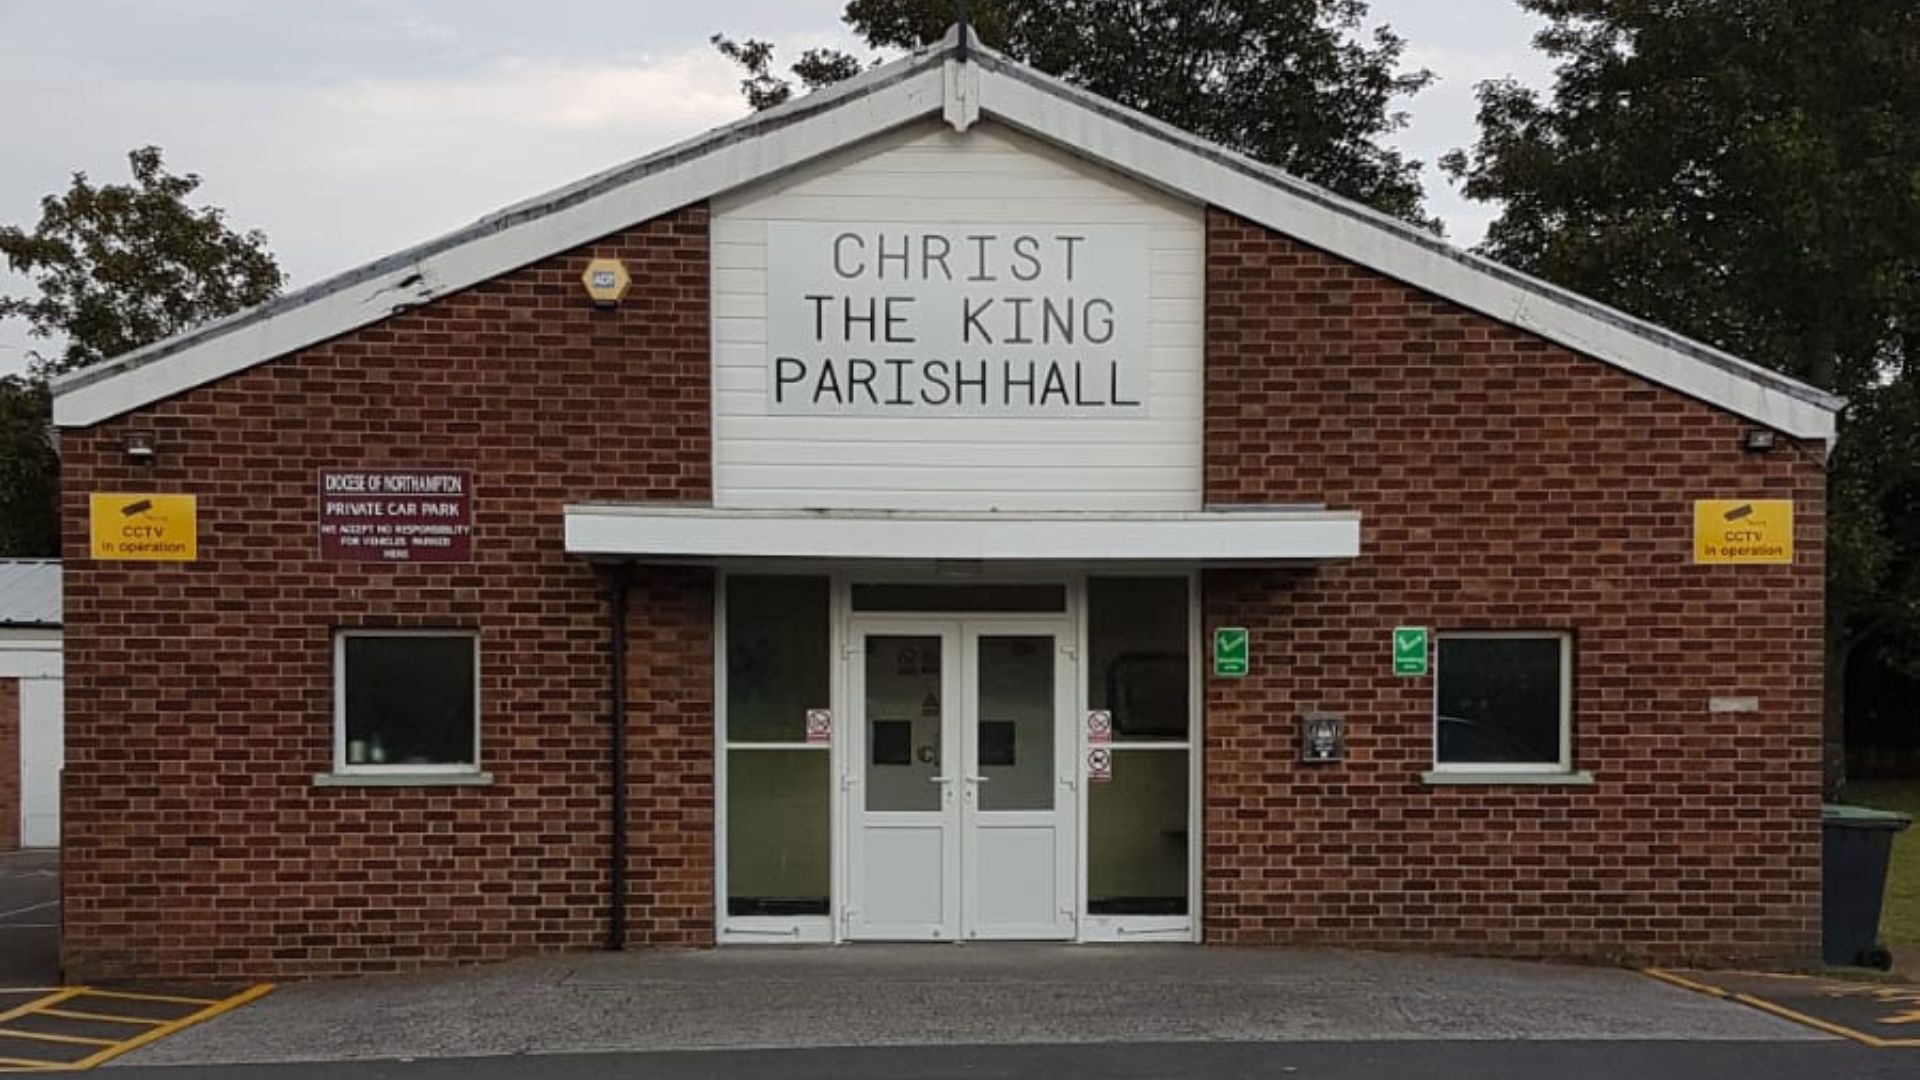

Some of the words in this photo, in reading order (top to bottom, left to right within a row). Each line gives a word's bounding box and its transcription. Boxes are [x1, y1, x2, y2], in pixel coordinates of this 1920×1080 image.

[833, 232, 1085, 281] CHRIST
[805, 294, 916, 343] THE
[963, 296, 1114, 345] KING
[775, 356, 987, 406] PARISH
[1004, 360, 1141, 407] HALL
[325, 474, 365, 491] DIOCESE
[368, 474, 382, 491] OF
[384, 474, 462, 492] NORTHAMPTON
[326, 502, 384, 516] PRIVATE
[387, 502, 417, 516] CAR
[421, 503, 459, 517] PARK
[122, 525, 163, 538] CCTV
[1725, 531, 1763, 542] CCTV
[119, 541, 186, 554] operation
[1721, 545, 1783, 559] operation
